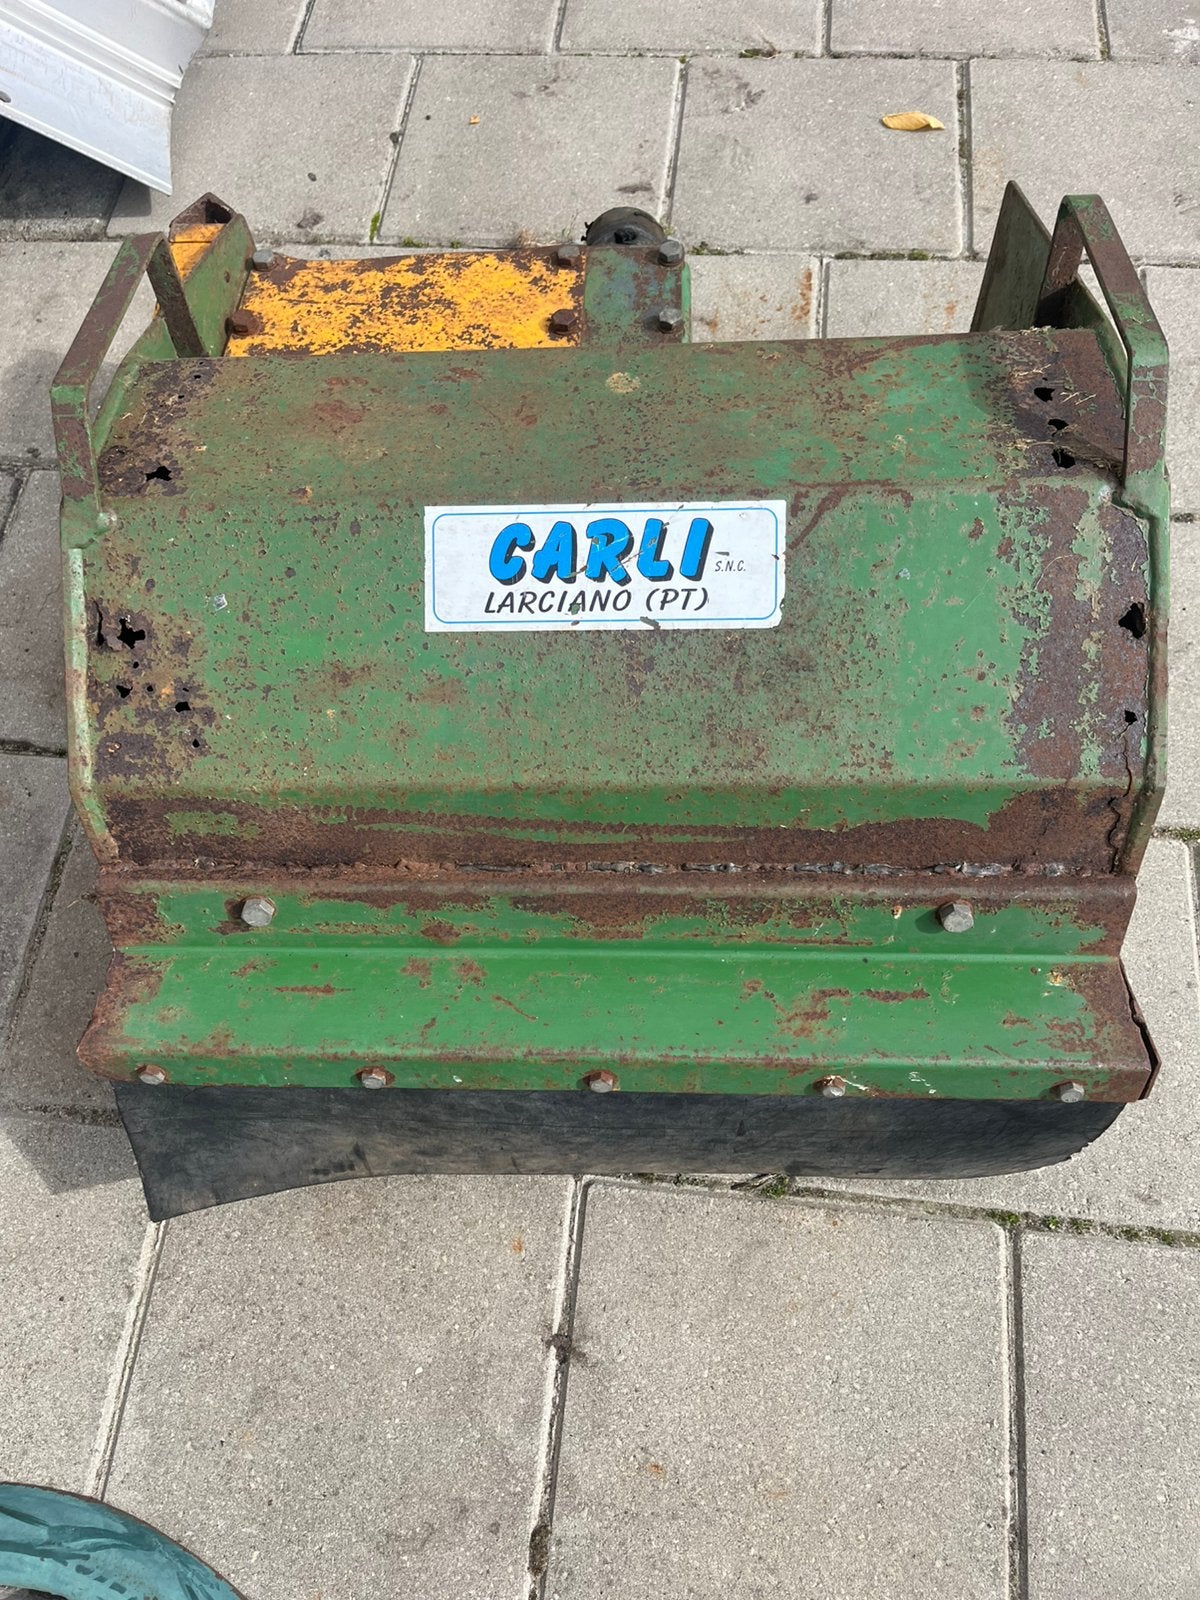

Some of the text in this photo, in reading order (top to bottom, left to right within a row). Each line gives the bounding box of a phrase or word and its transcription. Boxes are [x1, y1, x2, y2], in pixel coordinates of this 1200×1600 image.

[488, 517, 714, 586] CARLI
[714, 559, 747, 572] S.N.C.
[484, 587, 709, 614] LARCIANO (PT)
